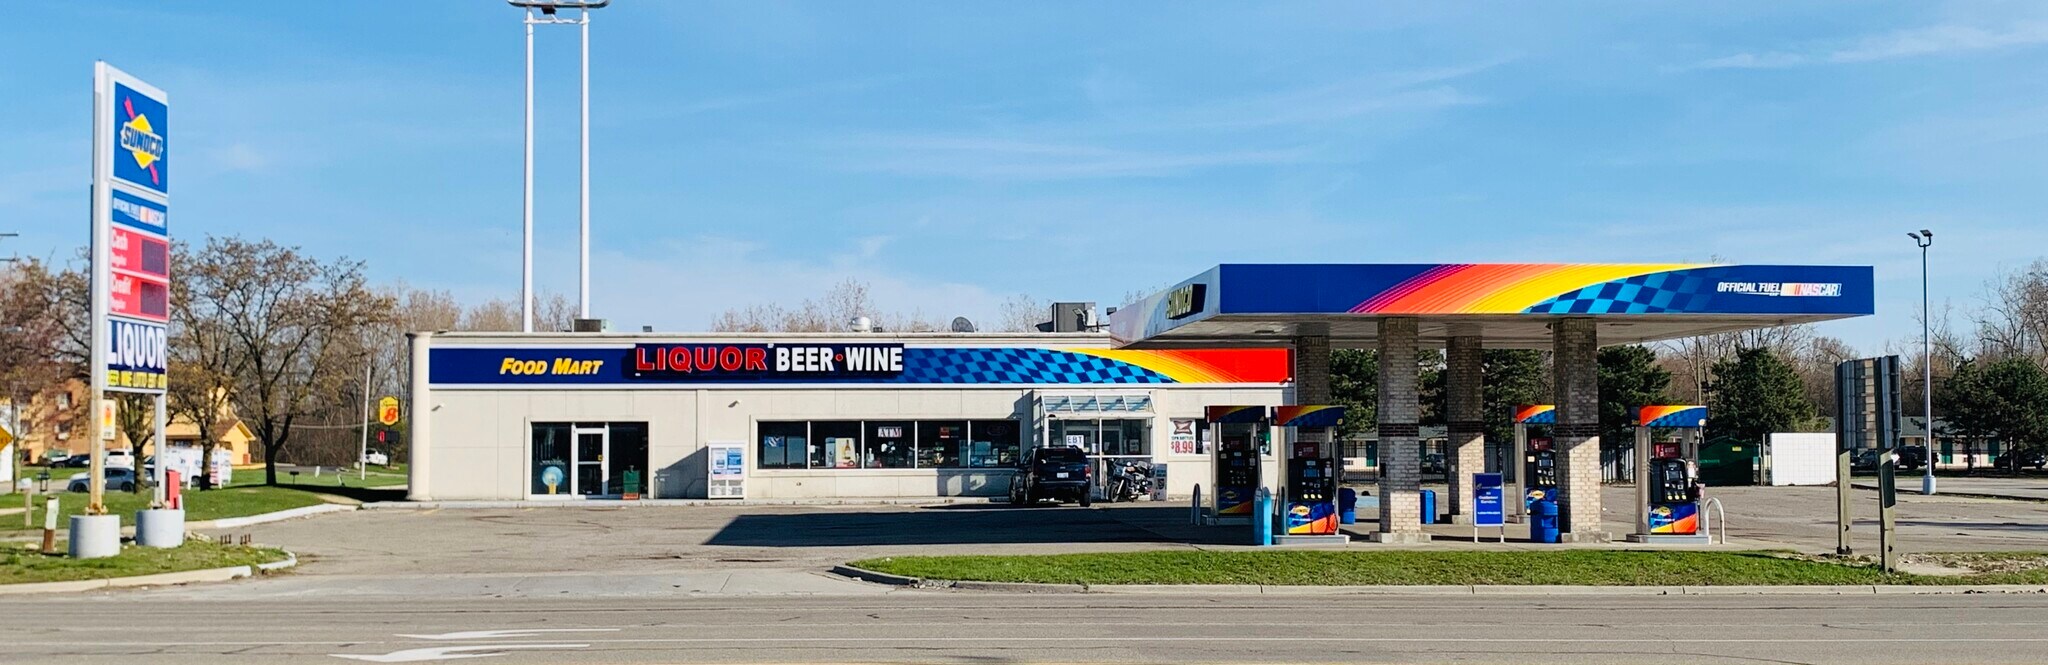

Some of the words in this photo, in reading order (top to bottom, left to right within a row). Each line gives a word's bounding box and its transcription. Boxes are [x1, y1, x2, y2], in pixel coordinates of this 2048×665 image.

[122, 125, 162, 157] SUNOCO
[111, 229, 128, 251] Cash
[111, 273, 132, 296] Credit
[1717, 282, 1757, 292] OFFICIAL
[1758, 282, 1780, 293] FUEL
[1799, 283, 1841, 296] NASCAR
[107, 320, 166, 370] LIQUOR
[499, 357, 549, 376] FOOD
[551, 357, 604, 376] MART
[636, 346, 769, 374] LIQUOR
[776, 346, 835, 372] BEER
[844, 346, 904, 372] WINE
[878, 427, 902, 438] ATM
[1067, 436, 1082, 444] EBT
[1171, 440, 1194, 454] $8.99
